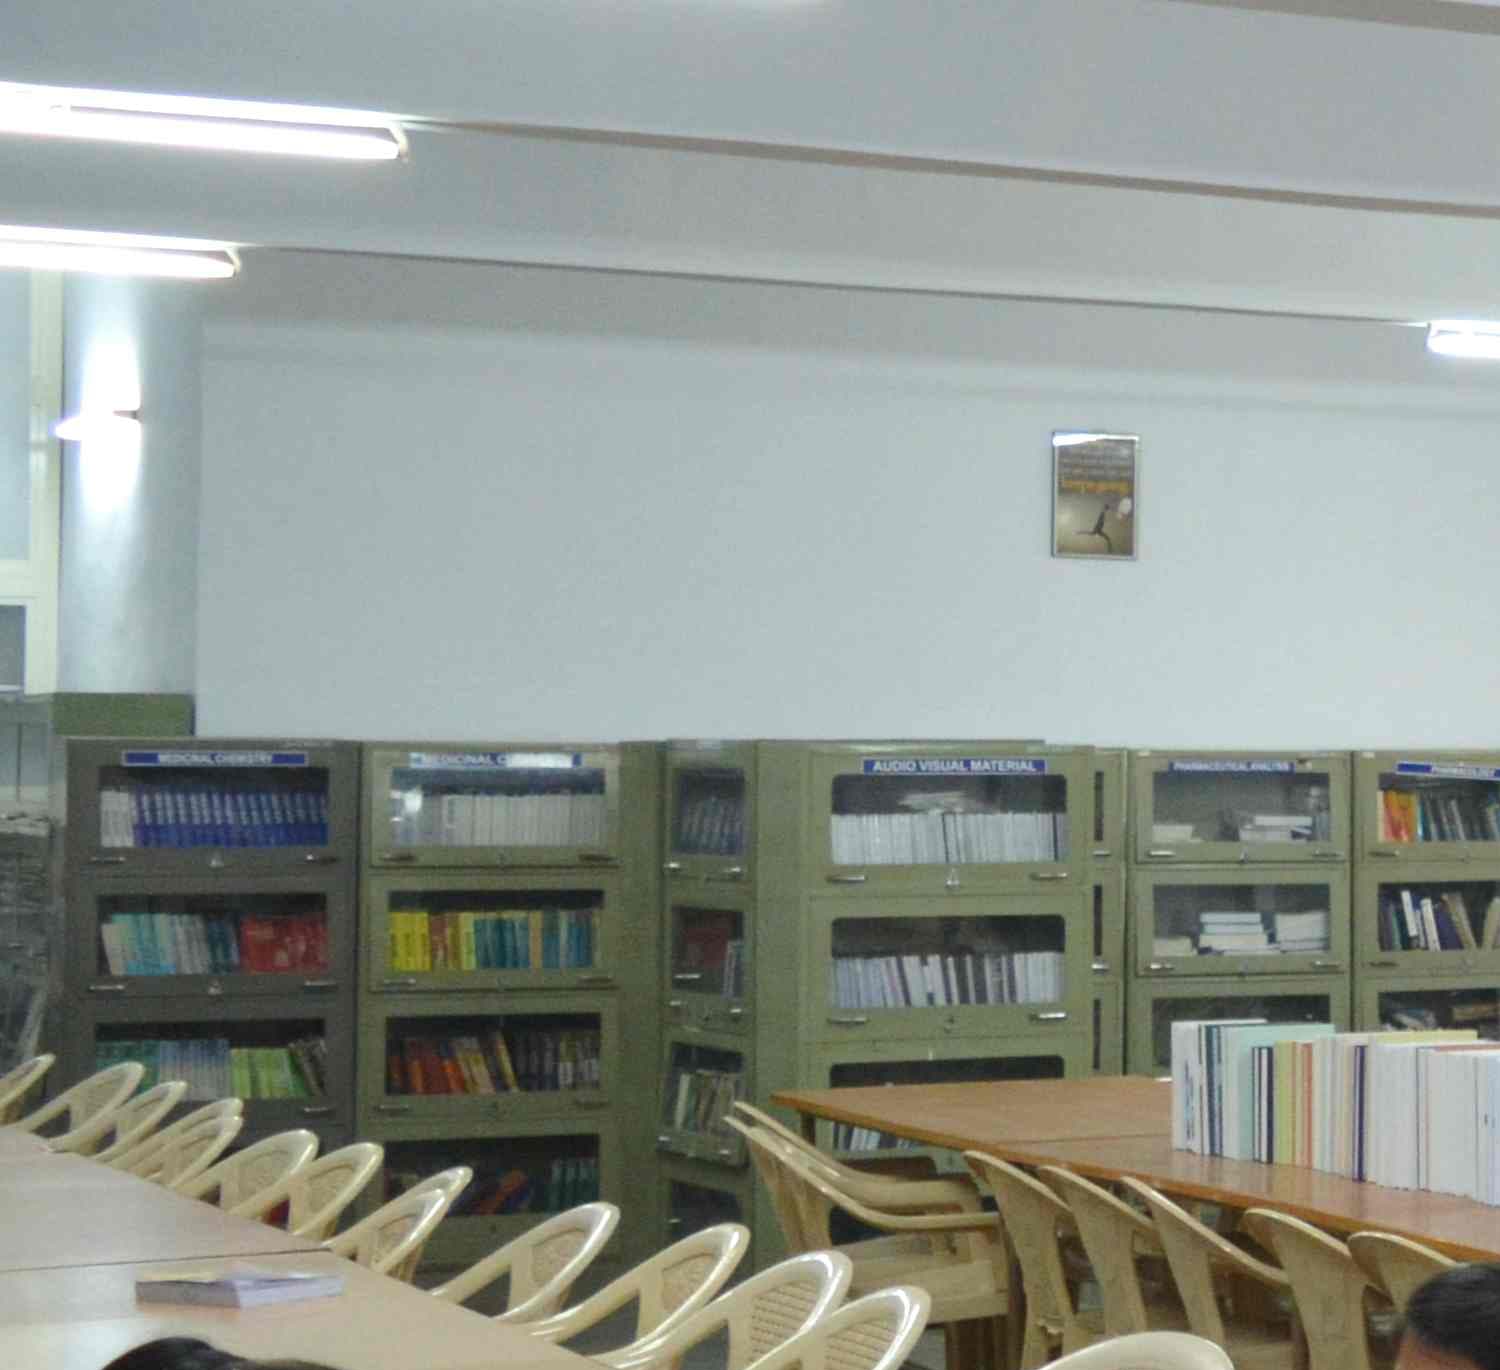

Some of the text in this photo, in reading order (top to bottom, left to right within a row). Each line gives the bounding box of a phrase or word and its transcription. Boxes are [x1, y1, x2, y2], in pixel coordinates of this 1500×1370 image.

[873, 760, 1037, 772] AUDIO VISUAL MATERIAL
